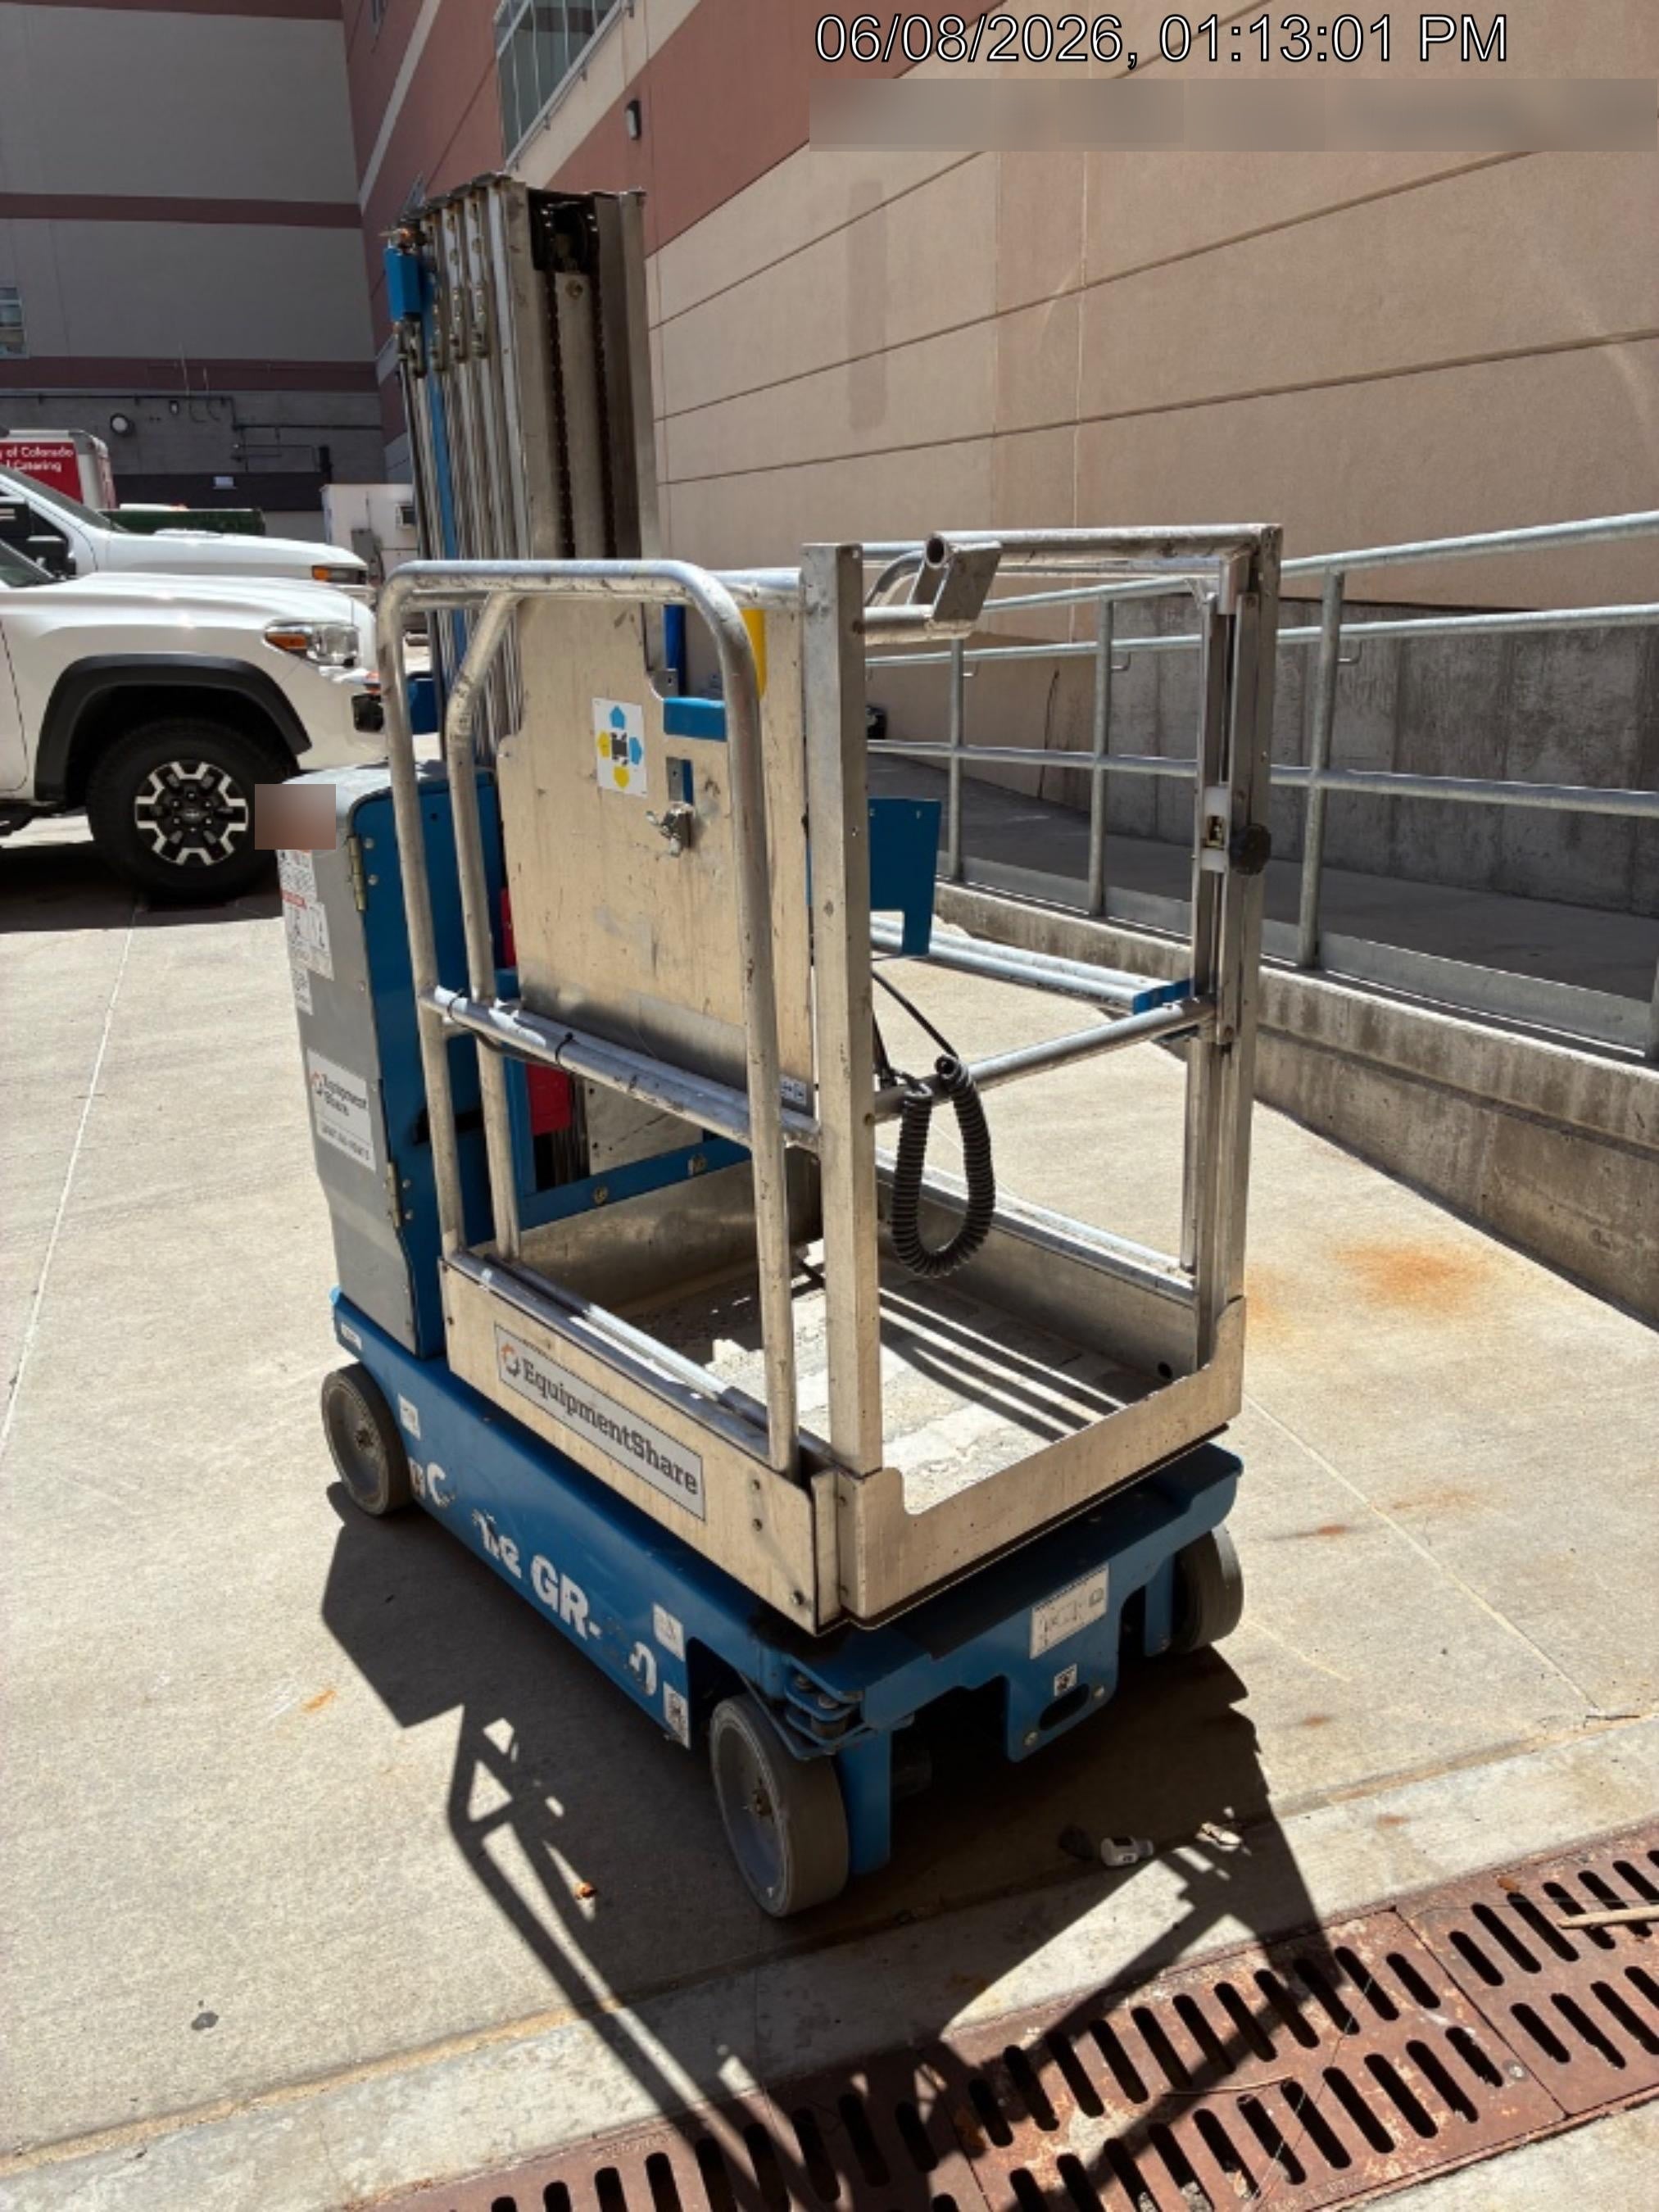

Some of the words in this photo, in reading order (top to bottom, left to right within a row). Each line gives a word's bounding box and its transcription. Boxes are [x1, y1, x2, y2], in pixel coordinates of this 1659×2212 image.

[7, 446, 17, 458] of
[21, 446, 74, 458] Colorado
[522, 1357, 698, 1495] EquipmentShare
